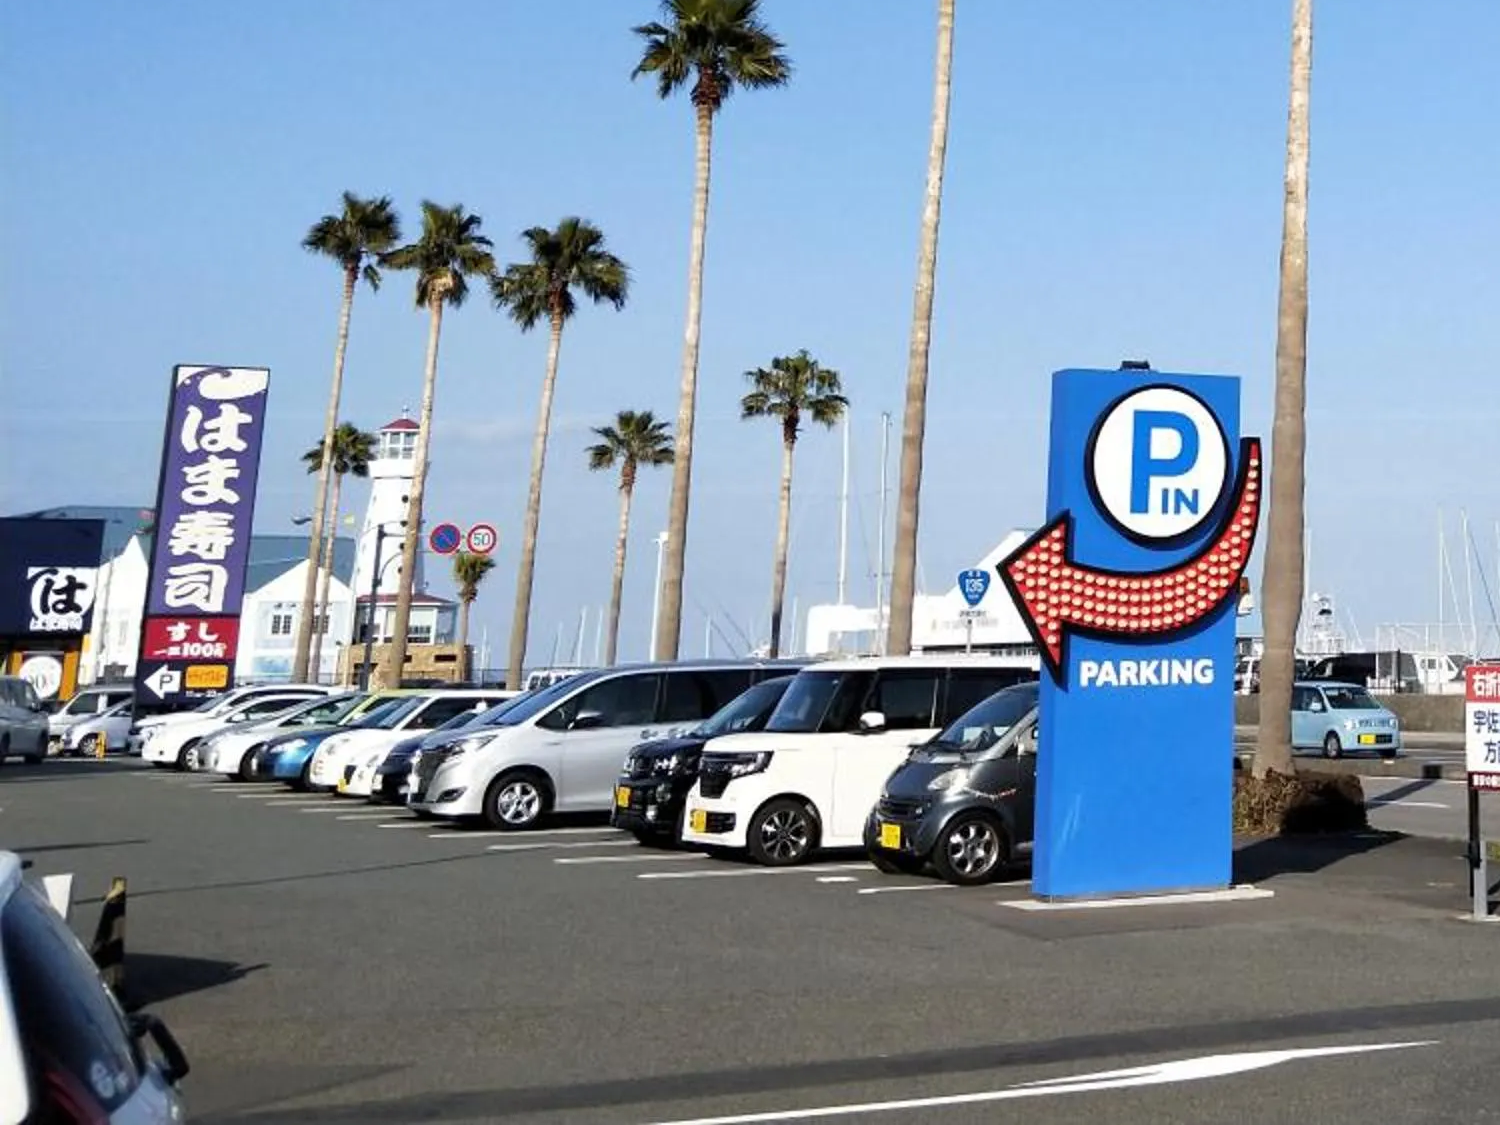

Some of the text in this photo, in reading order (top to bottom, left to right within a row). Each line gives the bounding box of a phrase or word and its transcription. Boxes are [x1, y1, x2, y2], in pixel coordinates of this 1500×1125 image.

[1129, 409, 1200, 515] P
[164, 403, 253, 613] はま寿司
[1161, 488, 1200, 515] IN
[473, 532, 492, 546] 50
[40, 574, 88, 616] は
[964, 578, 985, 593] 135
[165, 621, 220, 642] すし
[159, 674, 174, 691] P
[1079, 658, 1215, 688] PARKING
